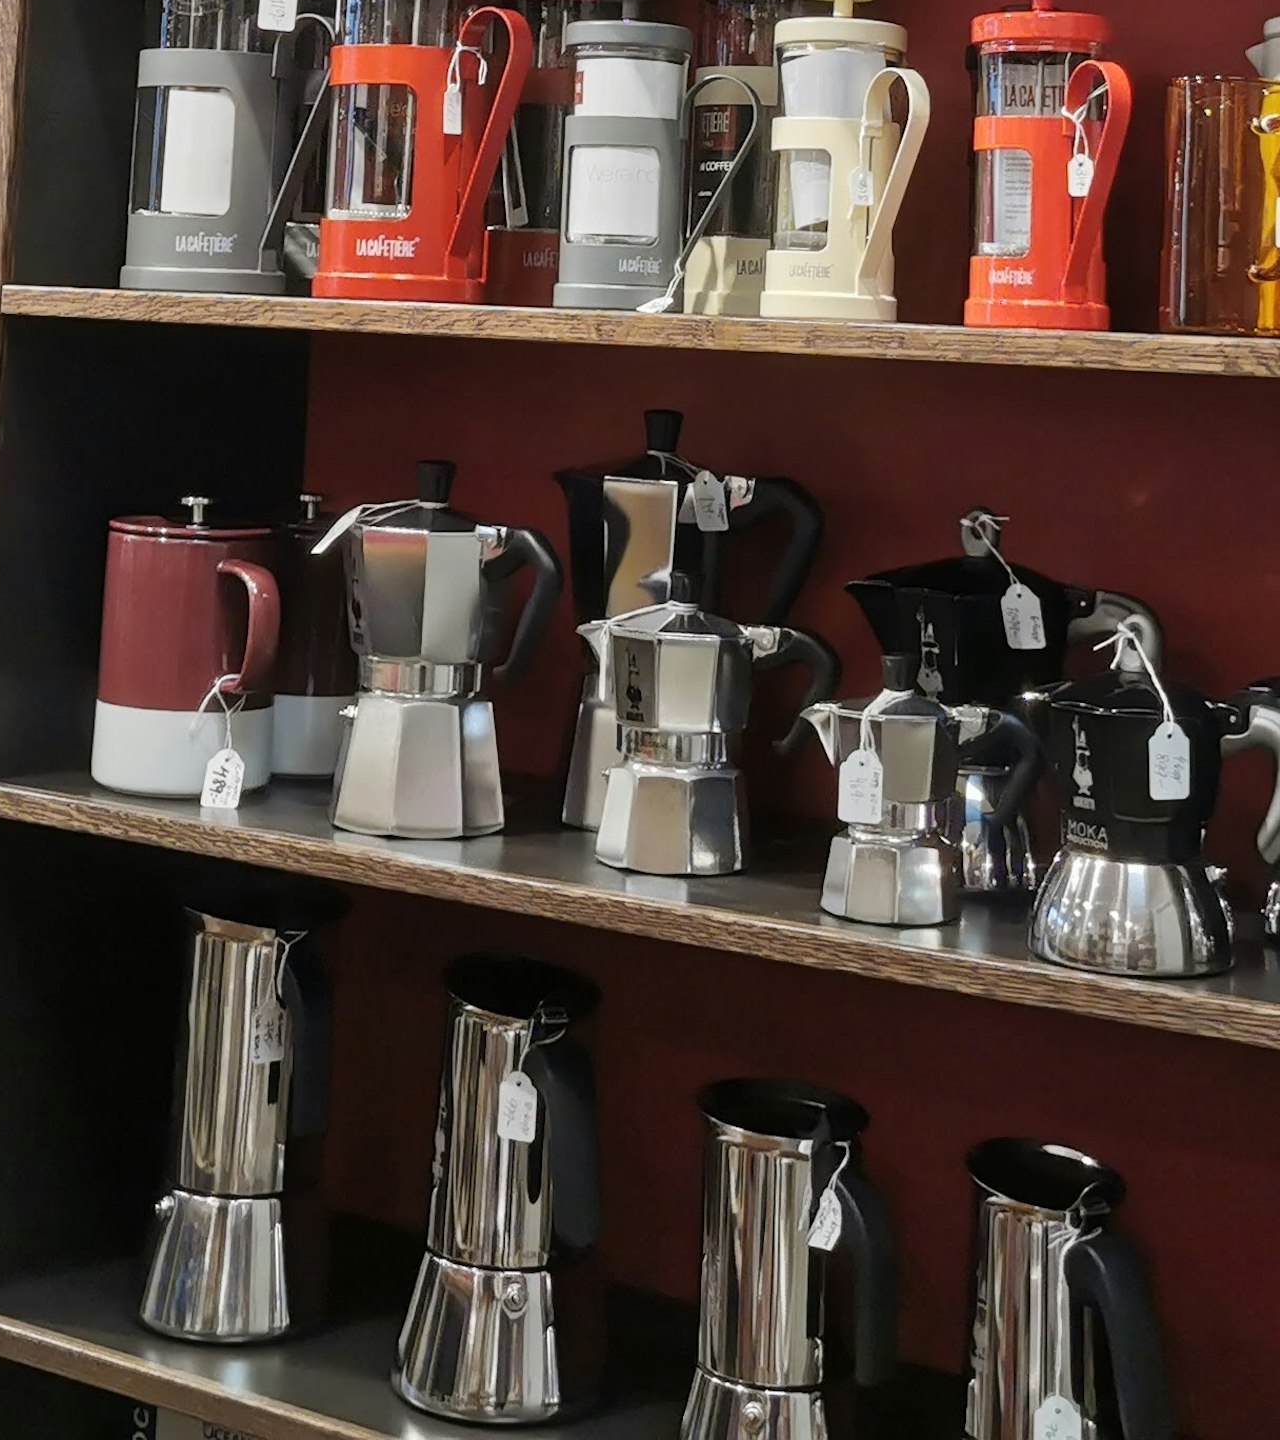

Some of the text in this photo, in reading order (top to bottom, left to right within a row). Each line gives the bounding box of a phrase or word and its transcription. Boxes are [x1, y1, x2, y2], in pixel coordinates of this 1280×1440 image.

[176, 236, 186, 252] LA
[356, 240, 366, 256] LA
[1068, 819, 1109, 842] MOKA
